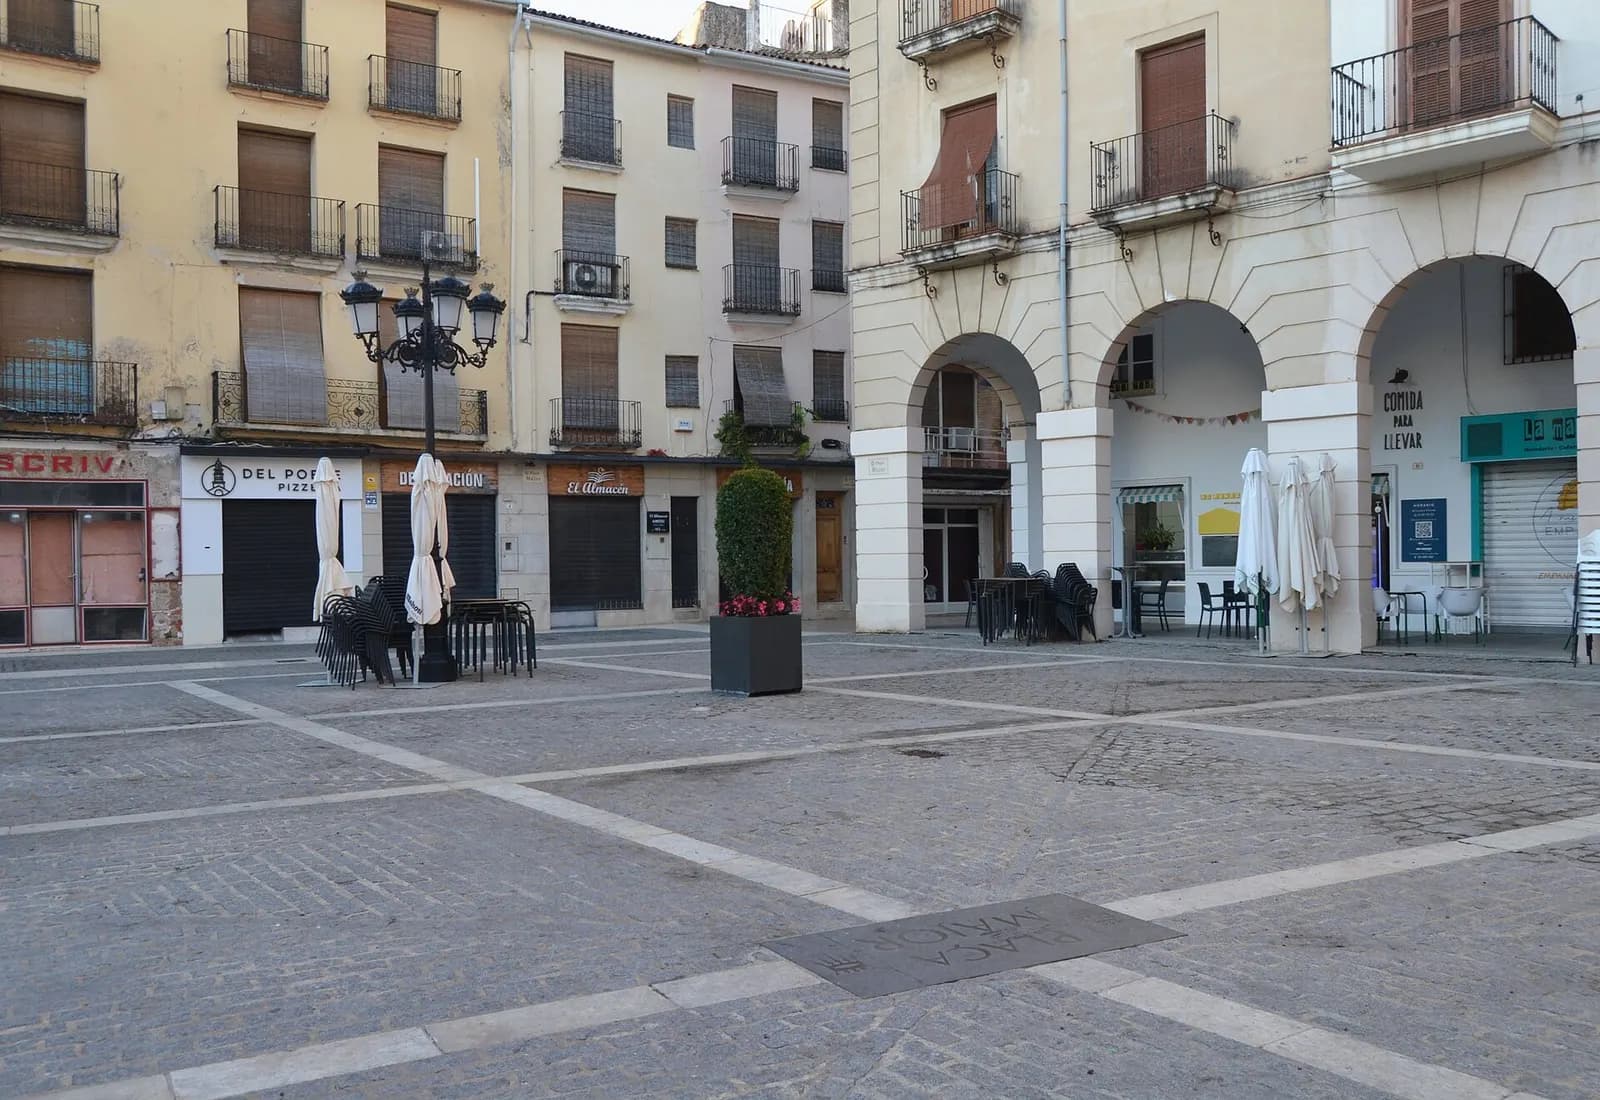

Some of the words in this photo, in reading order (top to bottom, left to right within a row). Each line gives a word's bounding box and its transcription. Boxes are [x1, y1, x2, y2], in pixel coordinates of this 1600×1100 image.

[1384, 390, 1423, 412] COMIDA
[1393, 414, 1413, 428] PARA
[1384, 432, 1423, 450] LLEVAR
[243, 468, 275, 480] DEL
[567, 481, 580, 494] El
[582, 482, 629, 495] Almacén
